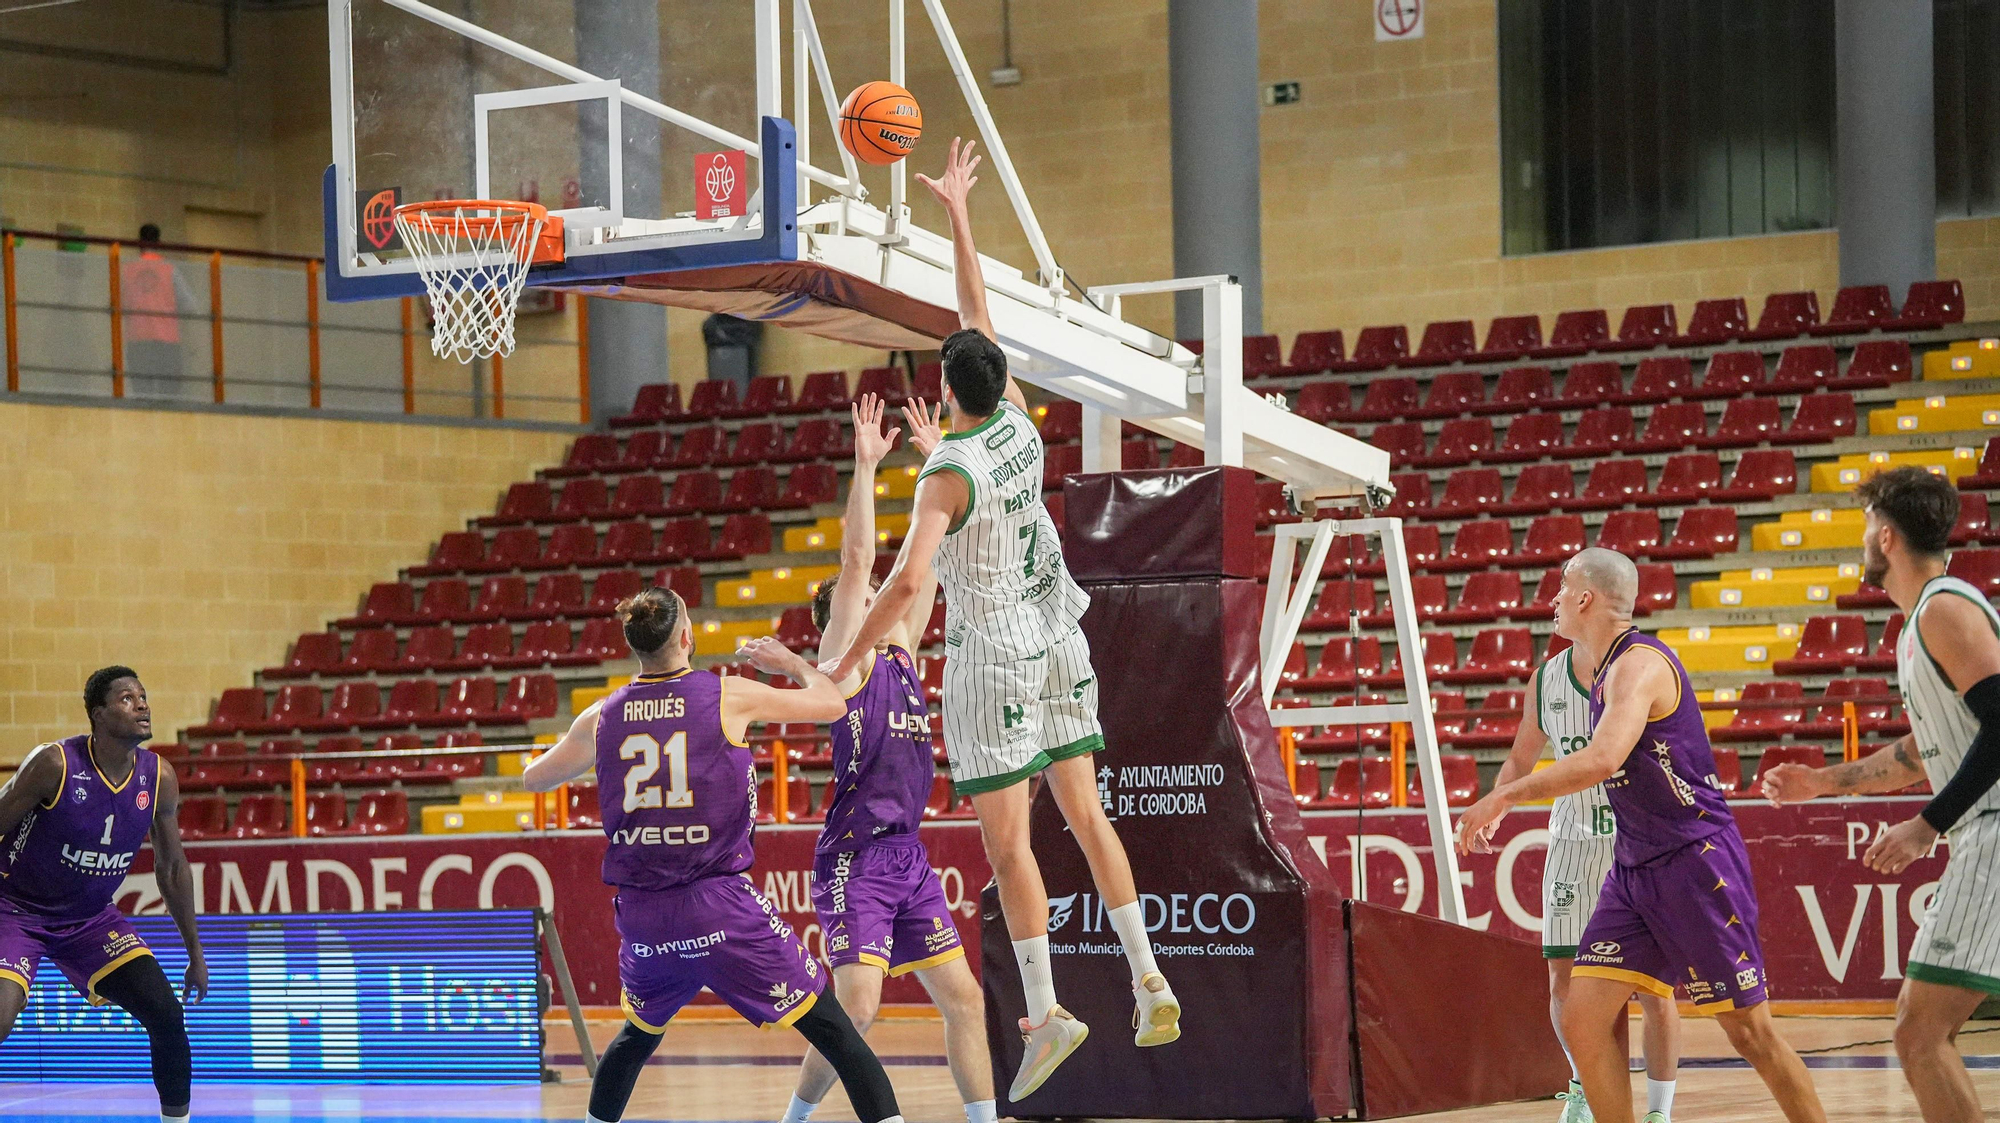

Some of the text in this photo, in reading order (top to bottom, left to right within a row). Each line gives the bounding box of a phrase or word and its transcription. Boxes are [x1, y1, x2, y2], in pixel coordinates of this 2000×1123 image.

[711, 208, 731, 217] FEB
[1018, 519, 1037, 580] 7
[623, 692, 686, 723] ARQUÉS
[619, 730, 694, 814] 21
[1118, 763, 1224, 789] AYUNTAMIENTO
[1118, 794, 1135, 816] DE
[100, 813, 115, 845] 1
[1592, 804, 1613, 836] 16
[612, 824, 710, 846] IVECO
[61, 843, 133, 869] UEMC
[655, 929, 727, 956] HYUNDAI
[831, 934, 849, 948] CBC
[1153, 943, 1205, 957] Deportes
[1206, 942, 1255, 956] Córdoba
[1580, 953, 1624, 964] HYUNDAI
[1735, 967, 1758, 986] CBC
[773, 987, 806, 1013] CRZA
